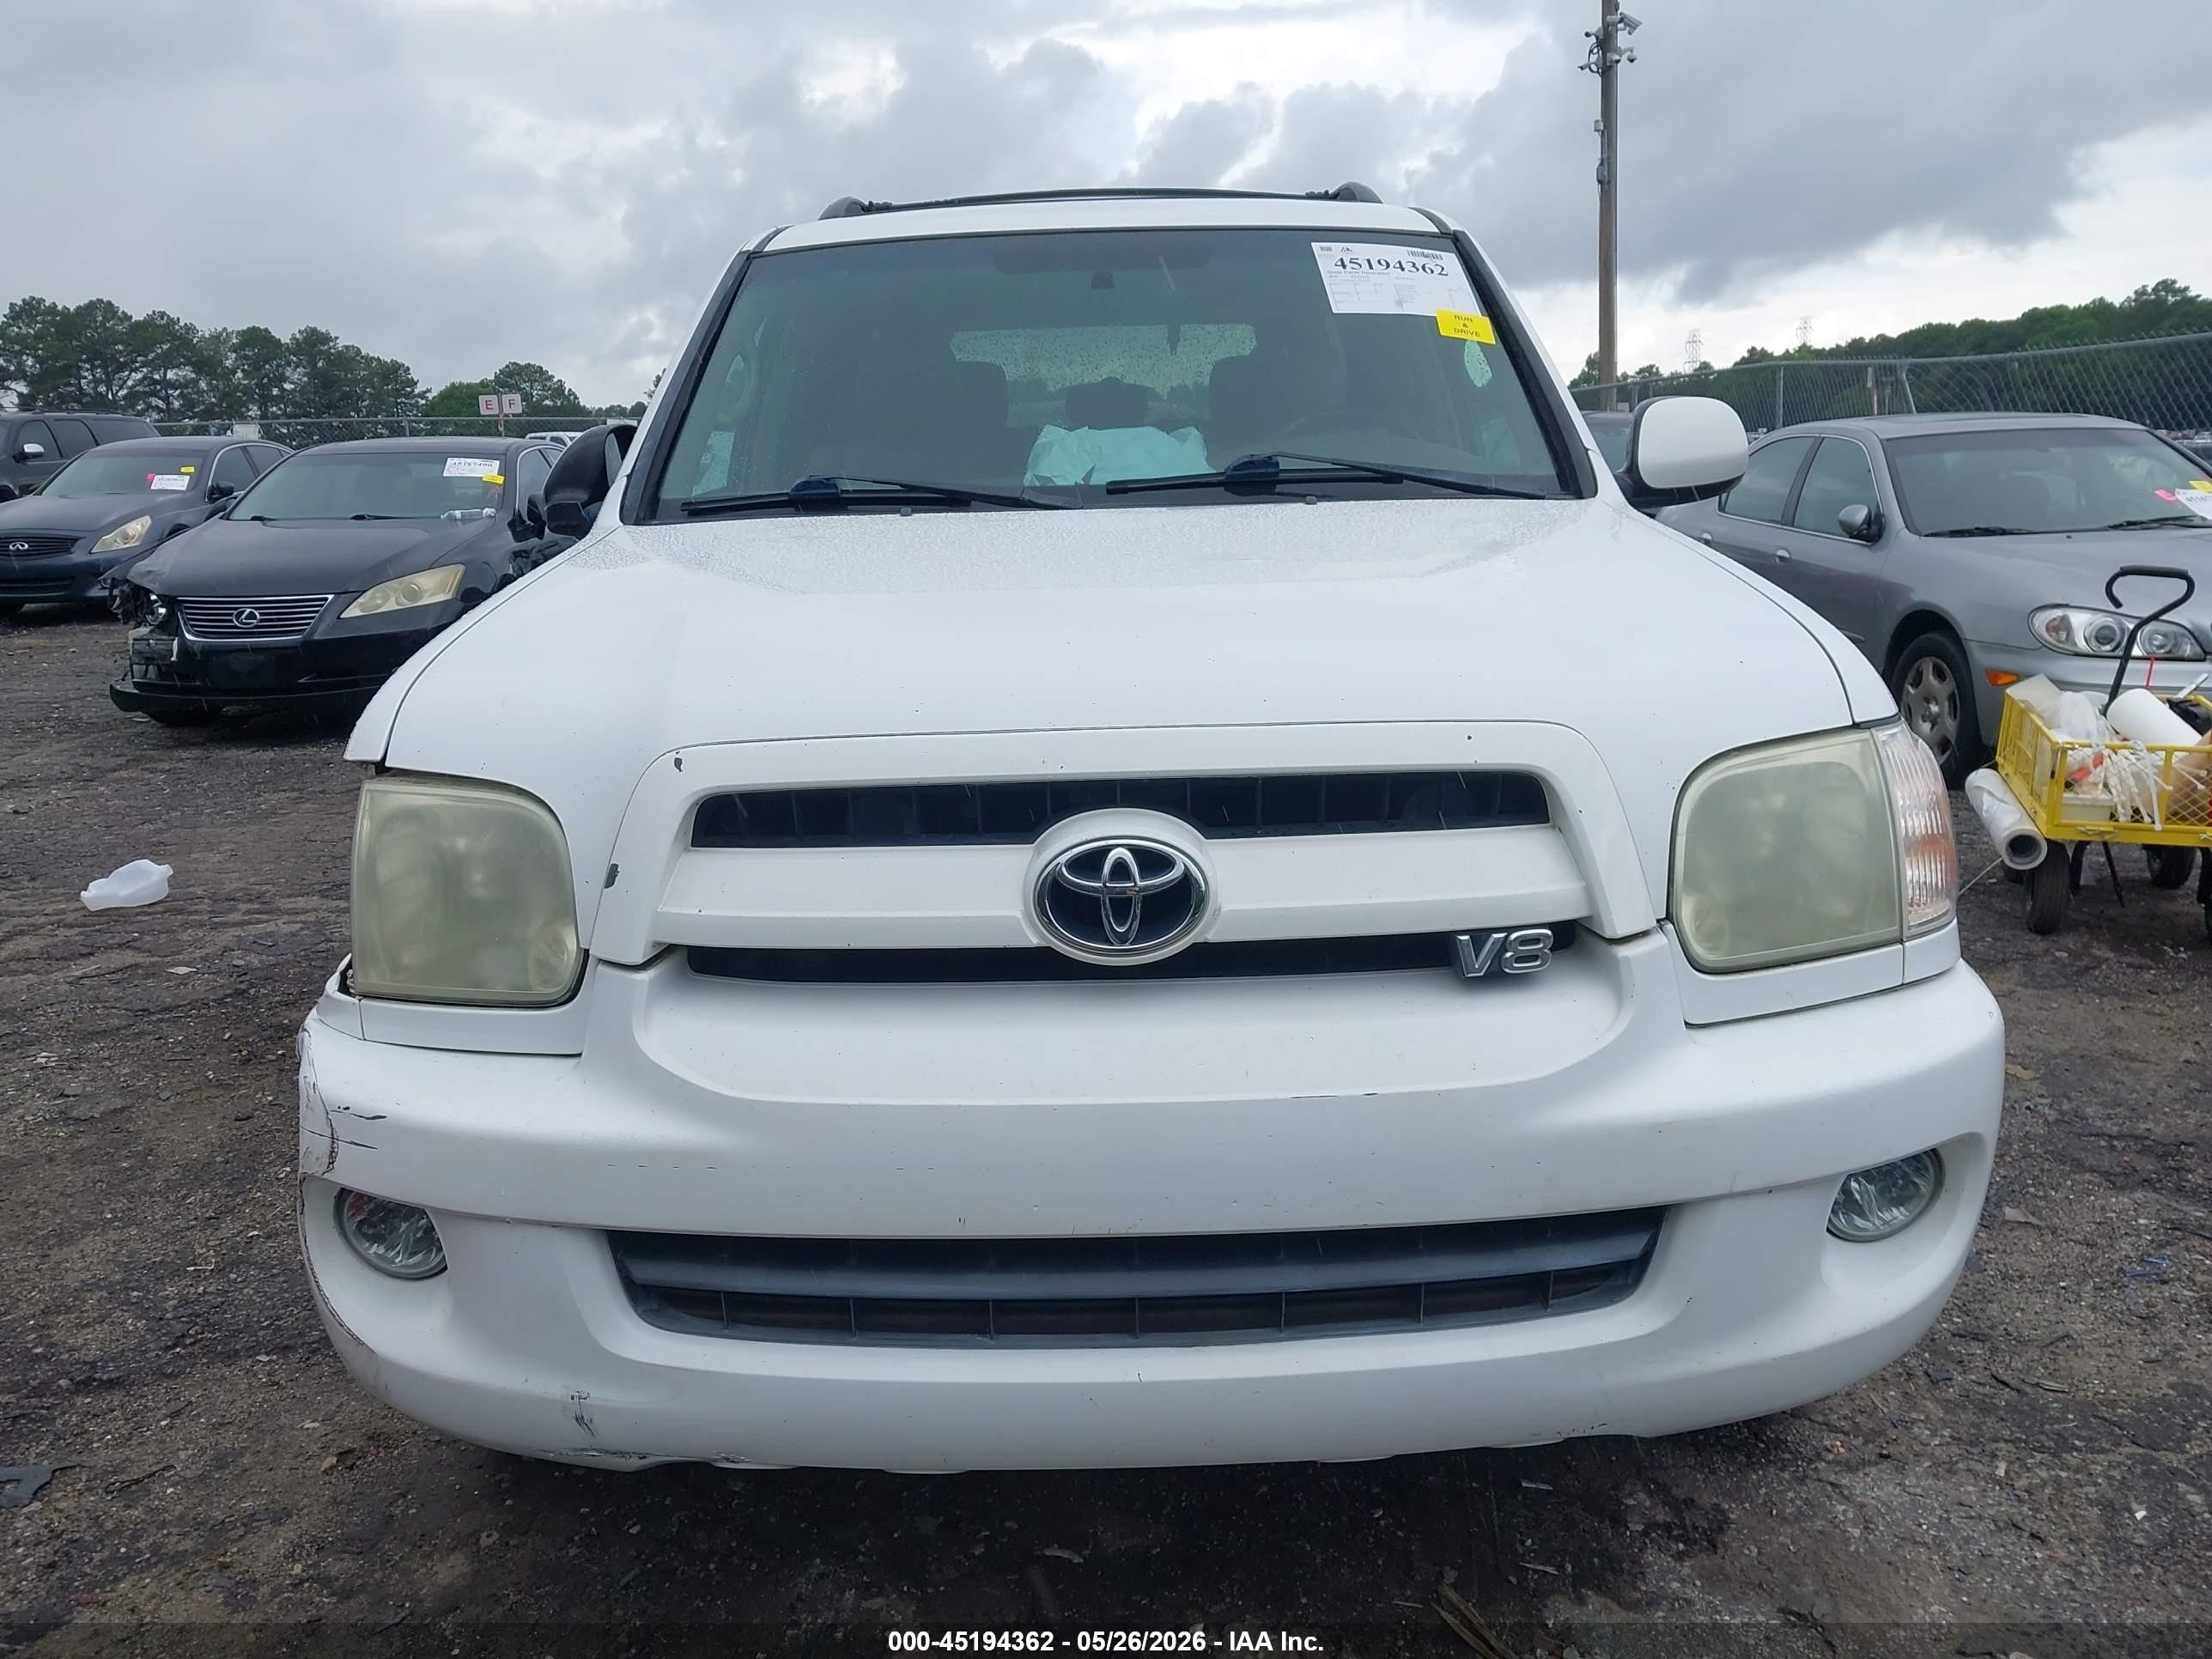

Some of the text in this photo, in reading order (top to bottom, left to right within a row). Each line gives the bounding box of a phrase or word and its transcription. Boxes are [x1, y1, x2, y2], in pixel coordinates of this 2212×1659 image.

[1334, 257, 1449, 276] 45194362
[1454, 314, 1474, 323] RUN
[1454, 327, 1481, 337] DRIVE
[485, 399, 494, 410] E
[508, 398, 516, 409] F
[1455, 928, 1553, 978] V8
